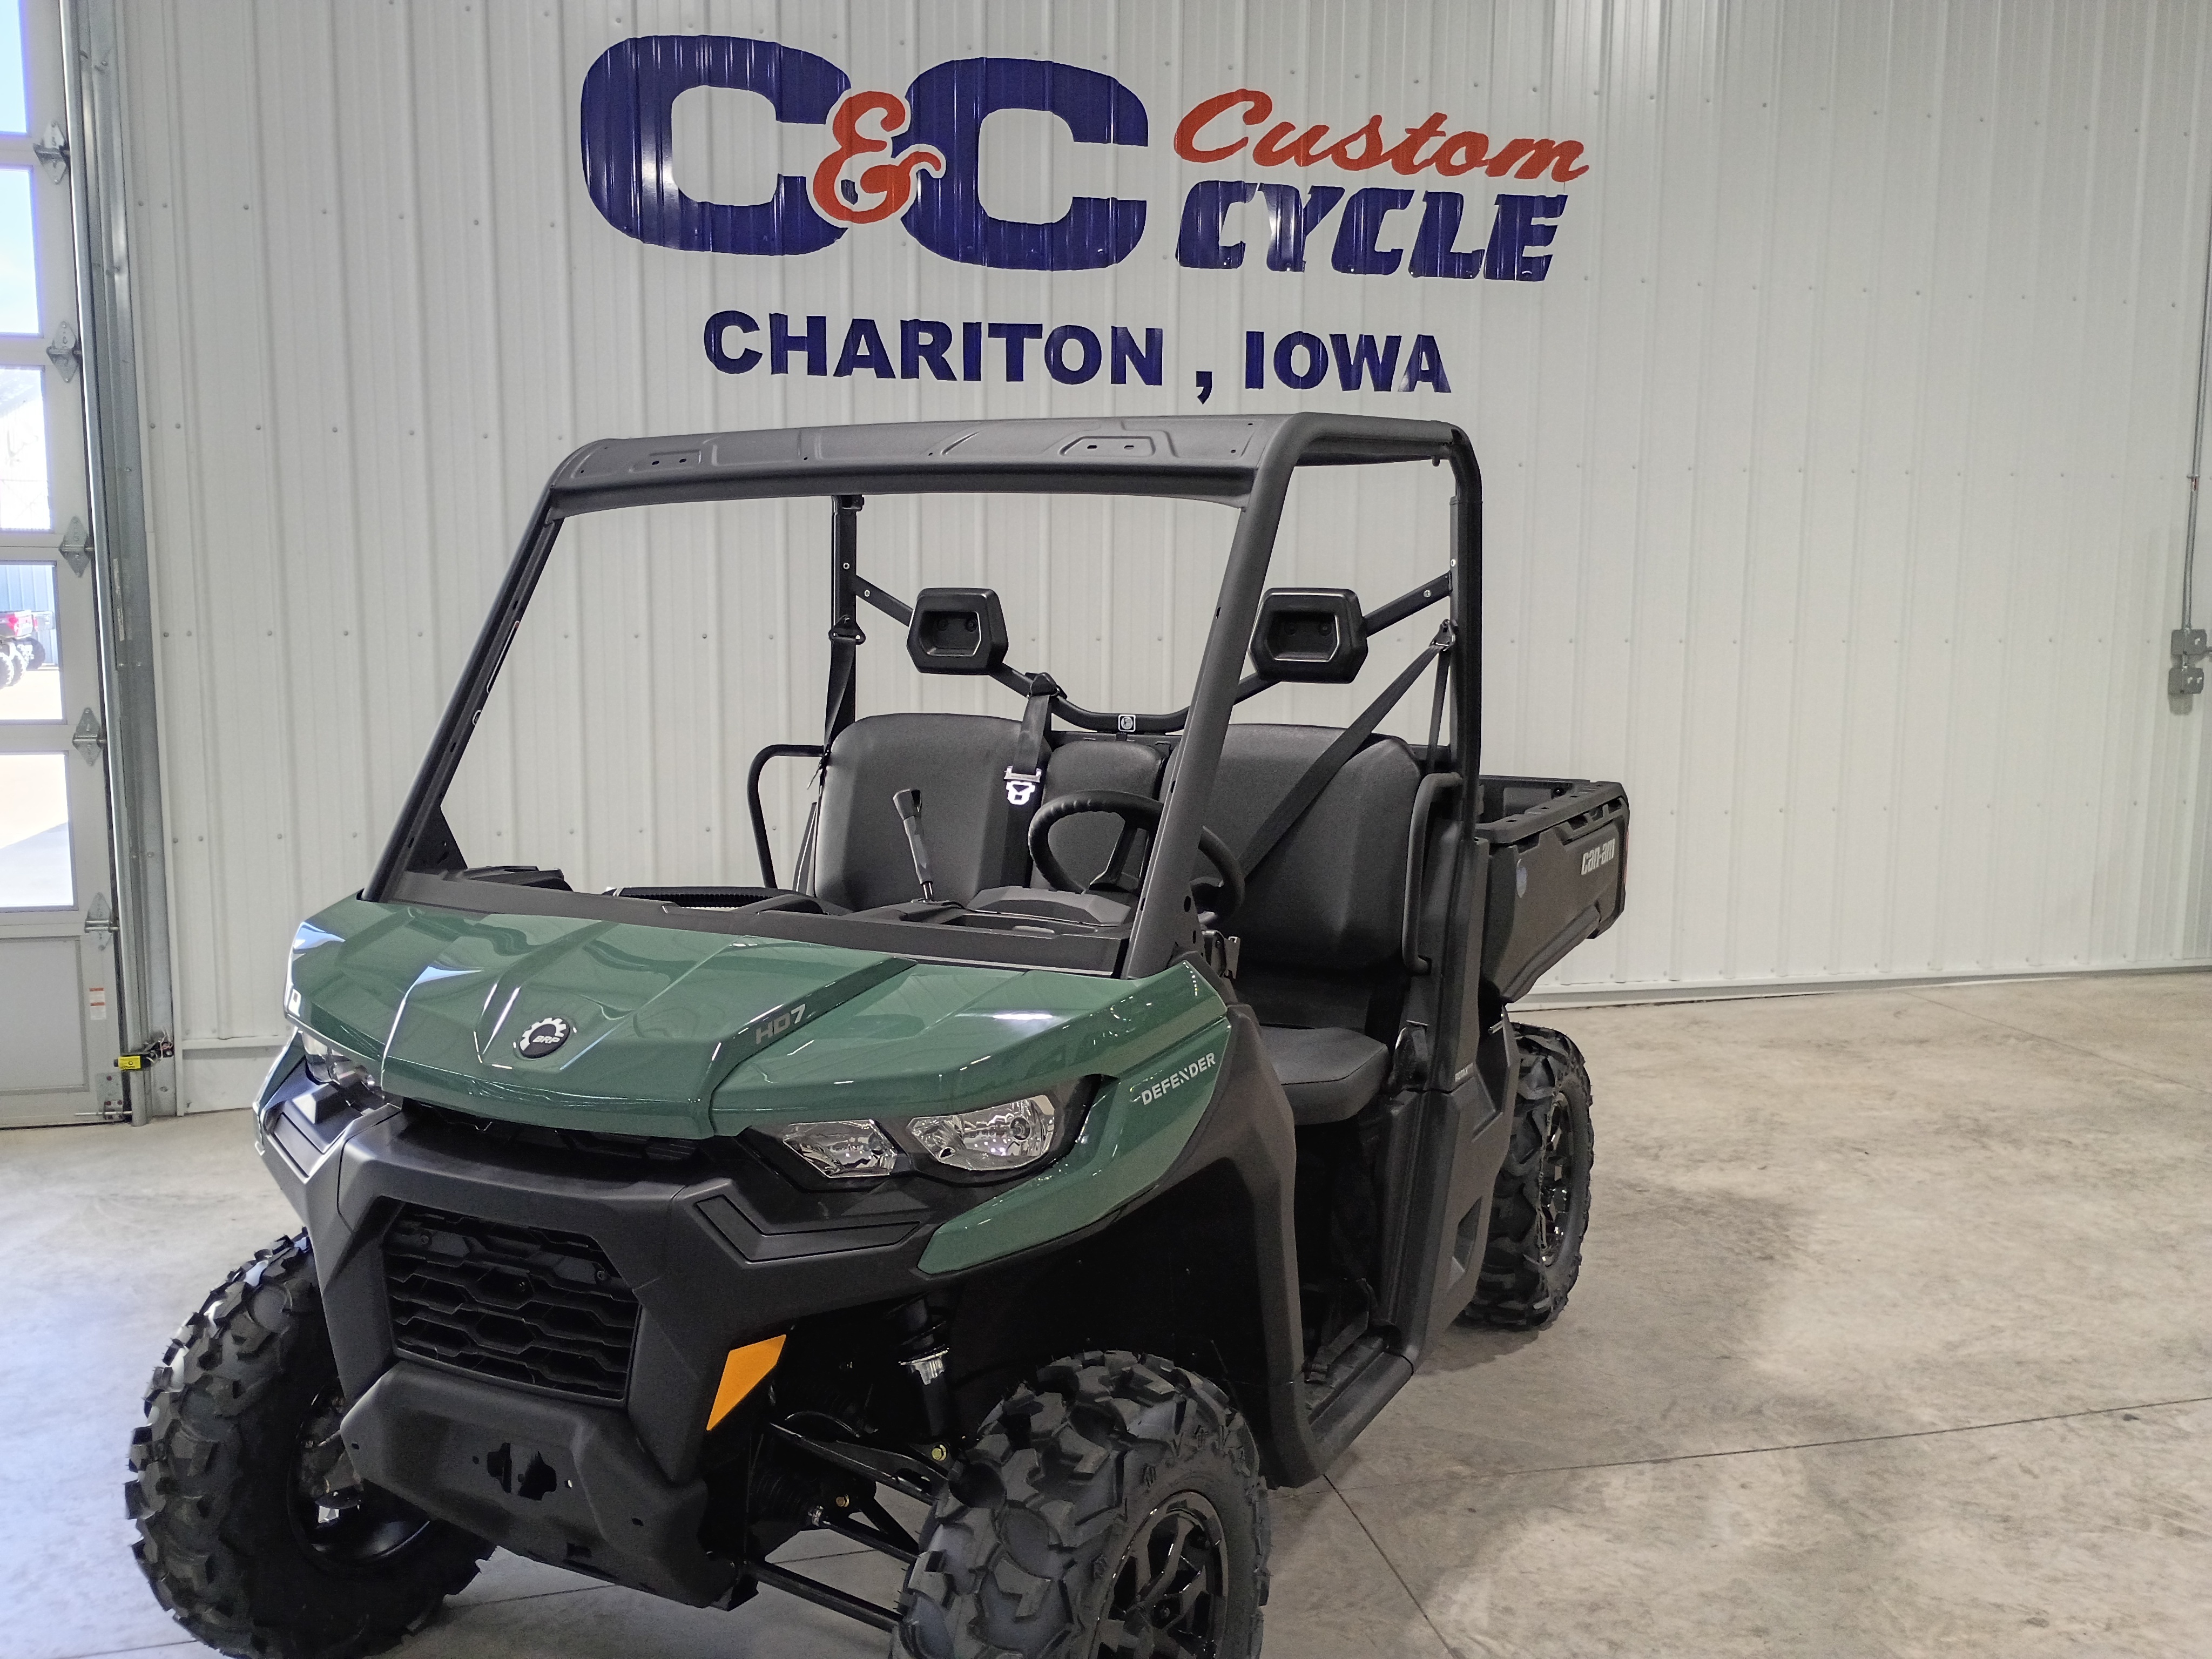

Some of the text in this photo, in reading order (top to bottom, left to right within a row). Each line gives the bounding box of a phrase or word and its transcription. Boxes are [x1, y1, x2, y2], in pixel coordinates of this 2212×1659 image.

[581, 35, 1148, 271] C&C
[1174, 89, 1589, 183] Custom
[1176, 180, 1568, 281] CYCLE
[704, 311, 1163, 385] CHARITON
[1245, 332, 1451, 393] IOWA
[1581, 838, 1616, 875] can-am
[532, 1035, 561, 1044] BRP
[756, 1003, 806, 1044] HD7
[1141, 1053, 1216, 1105] DEFENDER
